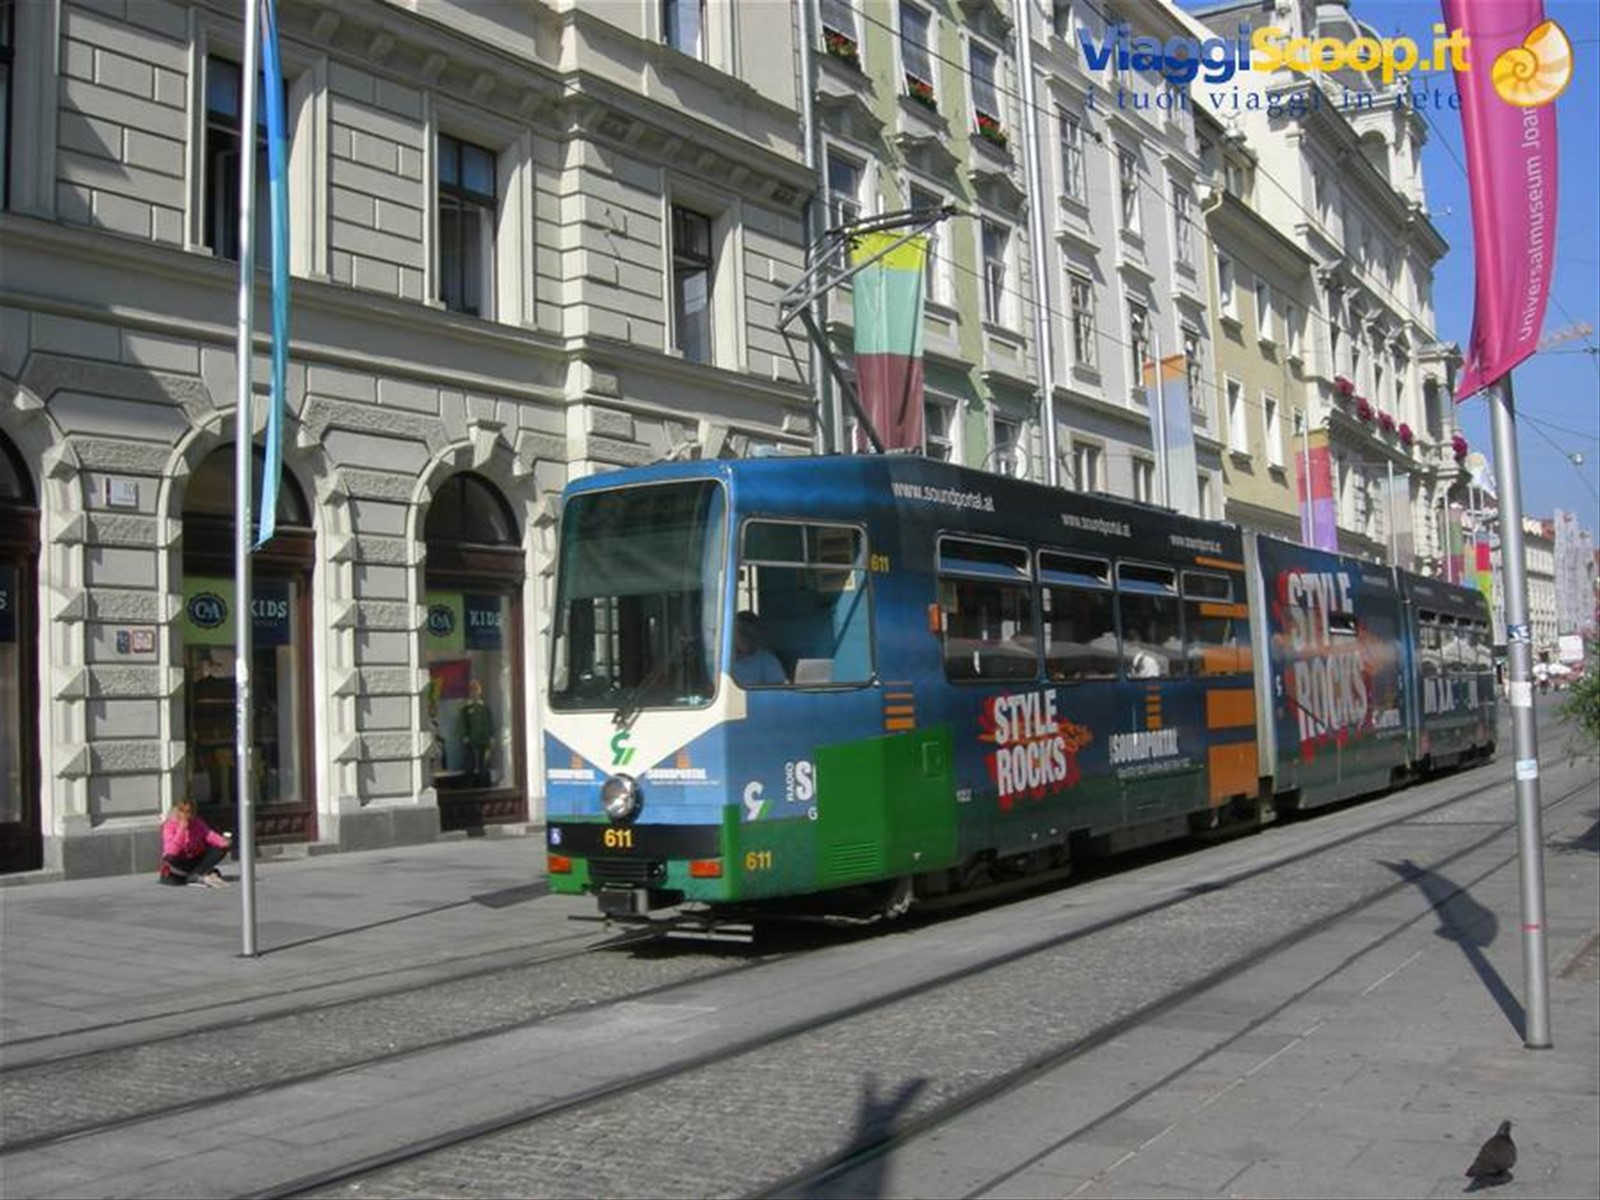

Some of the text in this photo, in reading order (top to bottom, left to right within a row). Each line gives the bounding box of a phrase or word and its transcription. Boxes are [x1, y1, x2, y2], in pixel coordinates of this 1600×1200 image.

[1518, 154, 1544, 342] Universalmuseum
[870, 553, 890, 574] 611
[994, 688, 1059, 745] STYLE
[784, 762, 795, 802] RADIO
[996, 736, 1067, 797] ROCKS
[604, 828, 633, 848] 611
[745, 850, 772, 871] 611
